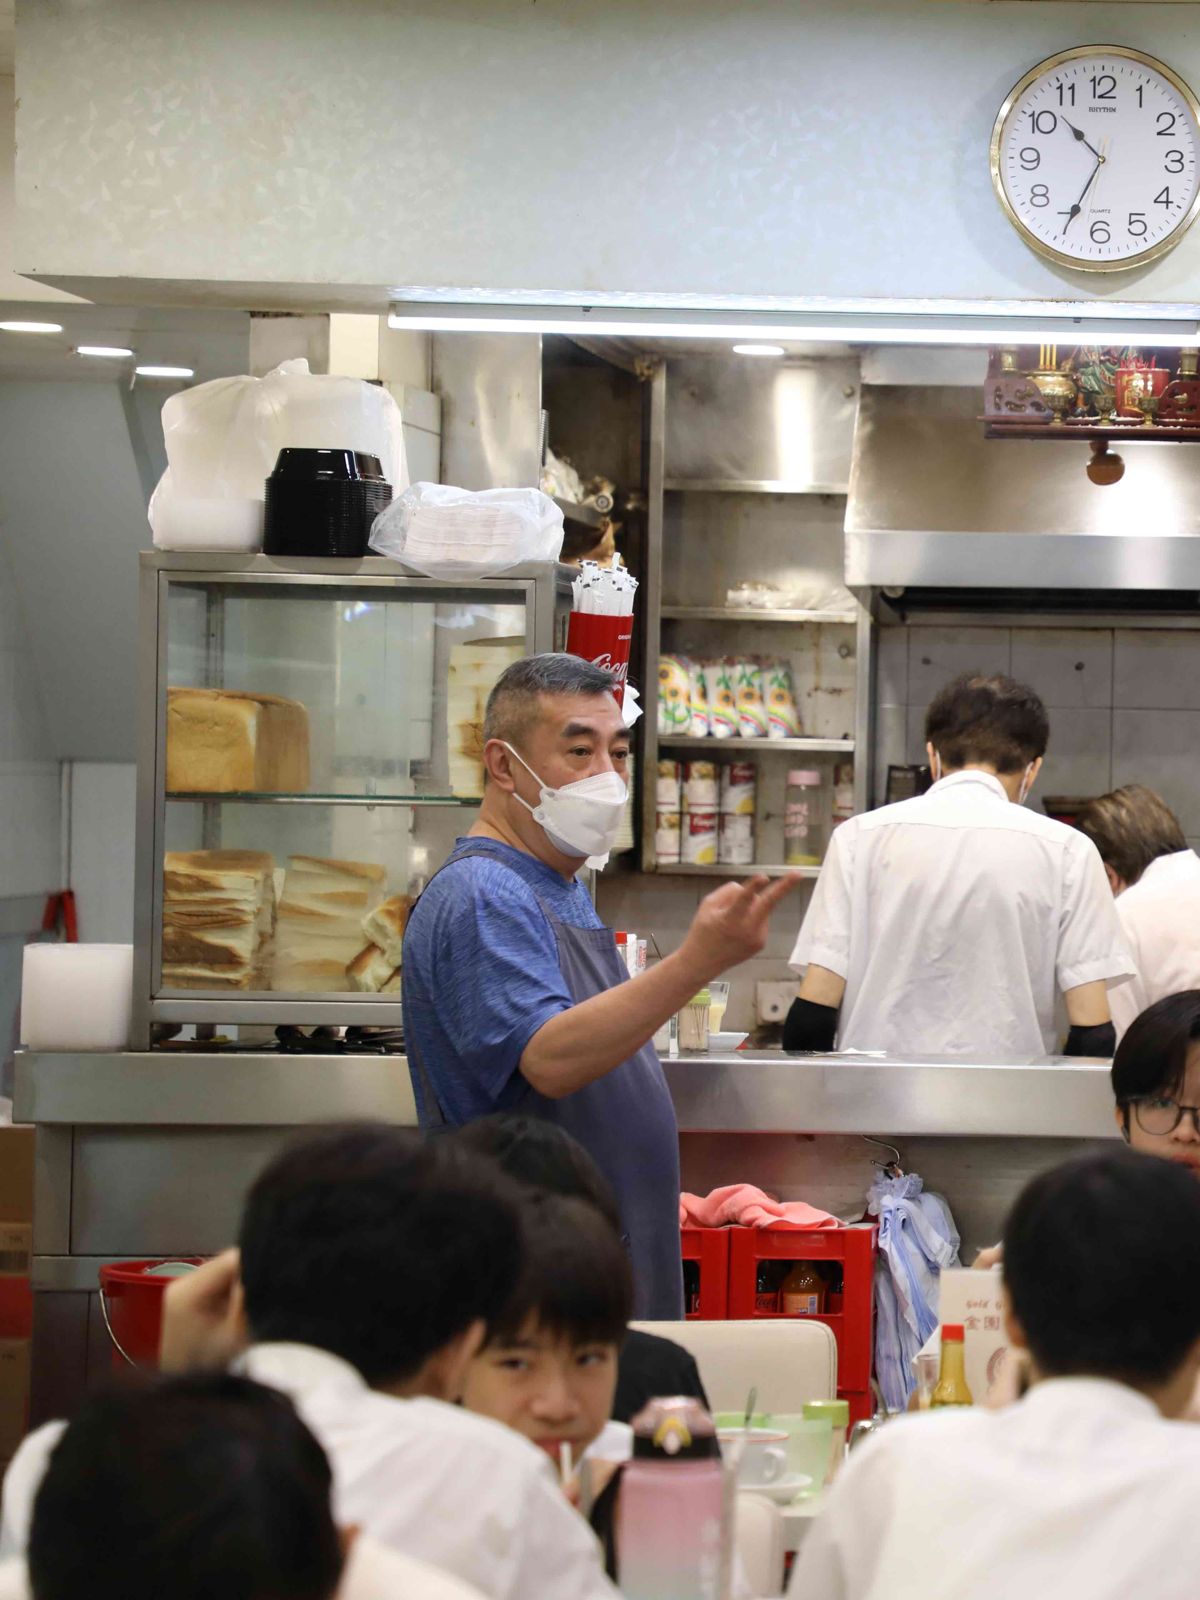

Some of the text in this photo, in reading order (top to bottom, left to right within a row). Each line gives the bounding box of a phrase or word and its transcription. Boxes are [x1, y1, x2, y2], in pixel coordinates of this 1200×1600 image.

[1056, 83, 1075, 106] 11
[1089, 75, 1117, 99] 12
[1136, 85, 1144, 108] 1
[1028, 110, 1057, 134] 10
[1156, 112, 1176, 136] 2
[1020, 147, 1041, 171] 9
[1164, 150, 1185, 173] 3
[1030, 184, 1050, 208] 8
[1153, 186, 1174, 210] 4
[1090, 221, 1111, 244] 6
[1128, 213, 1147, 236] 5
